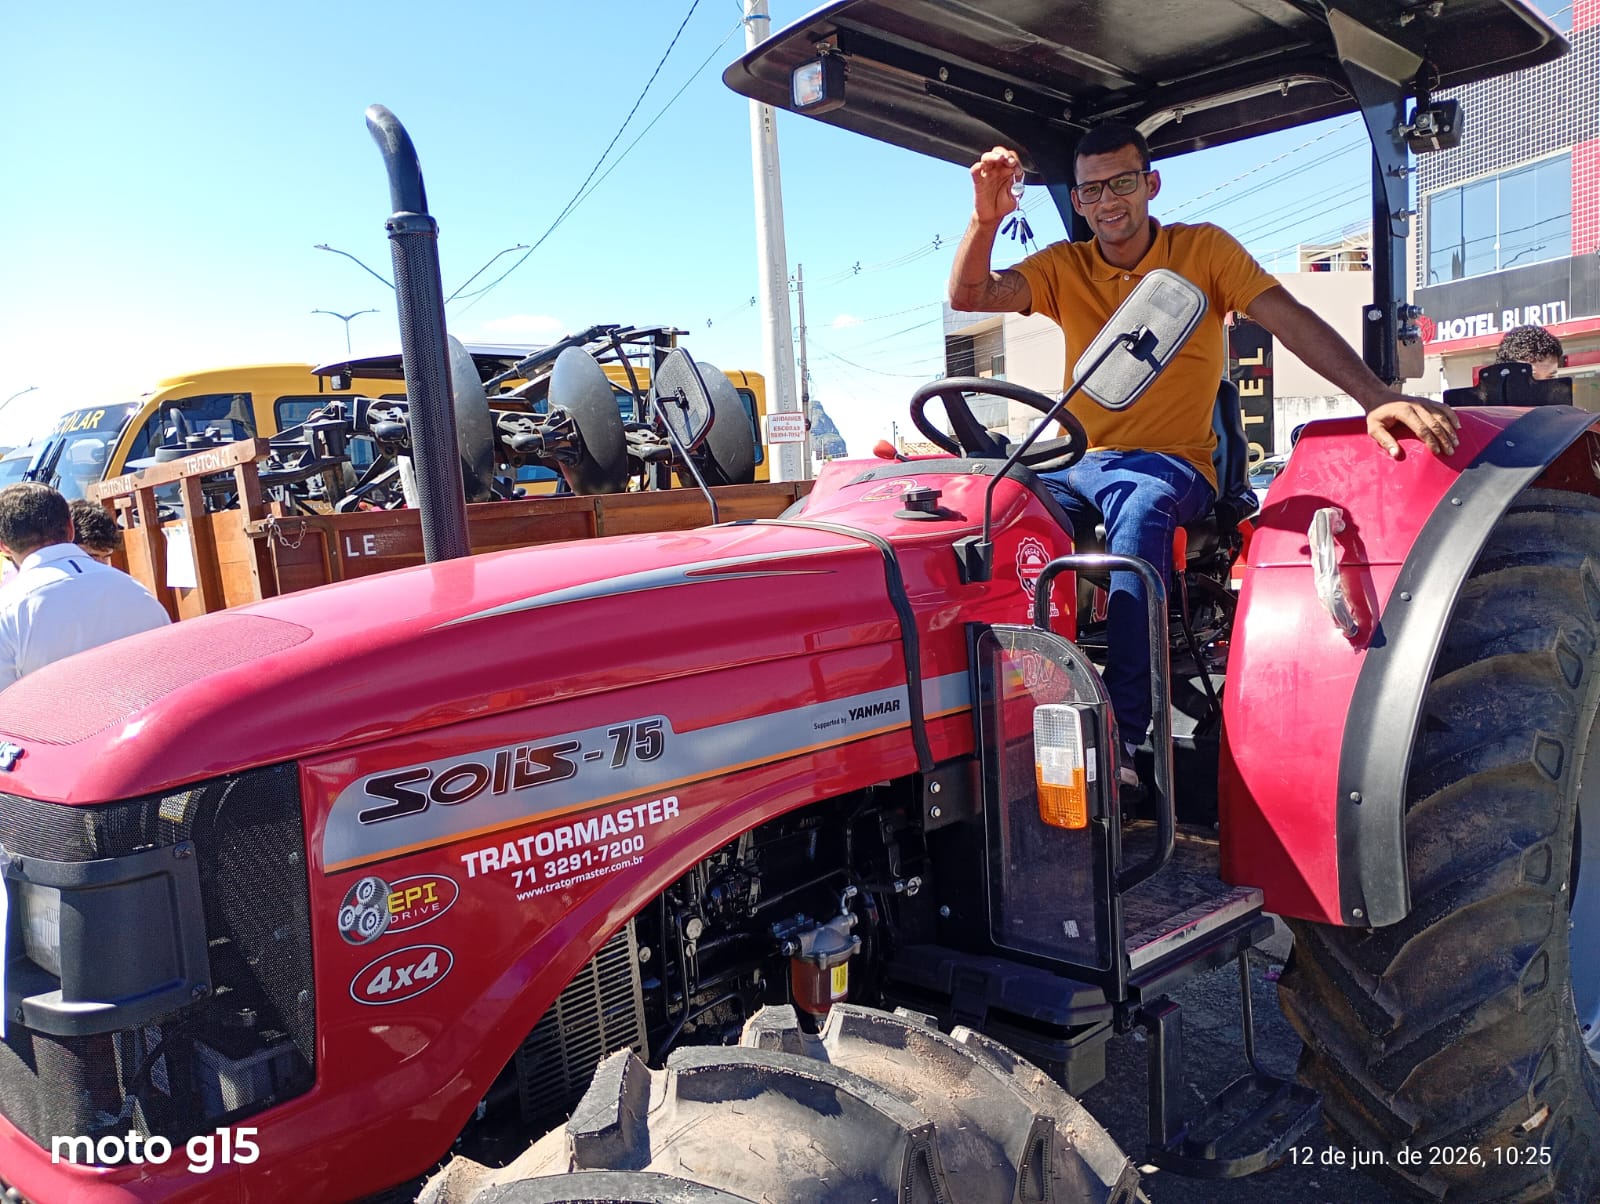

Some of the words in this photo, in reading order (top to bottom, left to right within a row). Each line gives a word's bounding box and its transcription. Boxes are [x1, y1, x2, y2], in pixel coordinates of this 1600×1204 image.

[1437, 312, 1499, 341] HOTEL
[1502, 300, 1566, 330] BURITI
[813, 717, 840, 730] Supported
[841, 716, 847, 725] by
[848, 699, 900, 721] YANMAR
[461, 796, 680, 878] TRATORMASTER
[511, 867, 537, 889] 71
[543, 834, 645, 879] 3291-7200
[516, 855, 645, 901] www.tratormaster.com.br
[387, 881, 439, 914] EPI
[390, 902, 441, 924] DRIVE
[366, 951, 439, 995] 4x4
